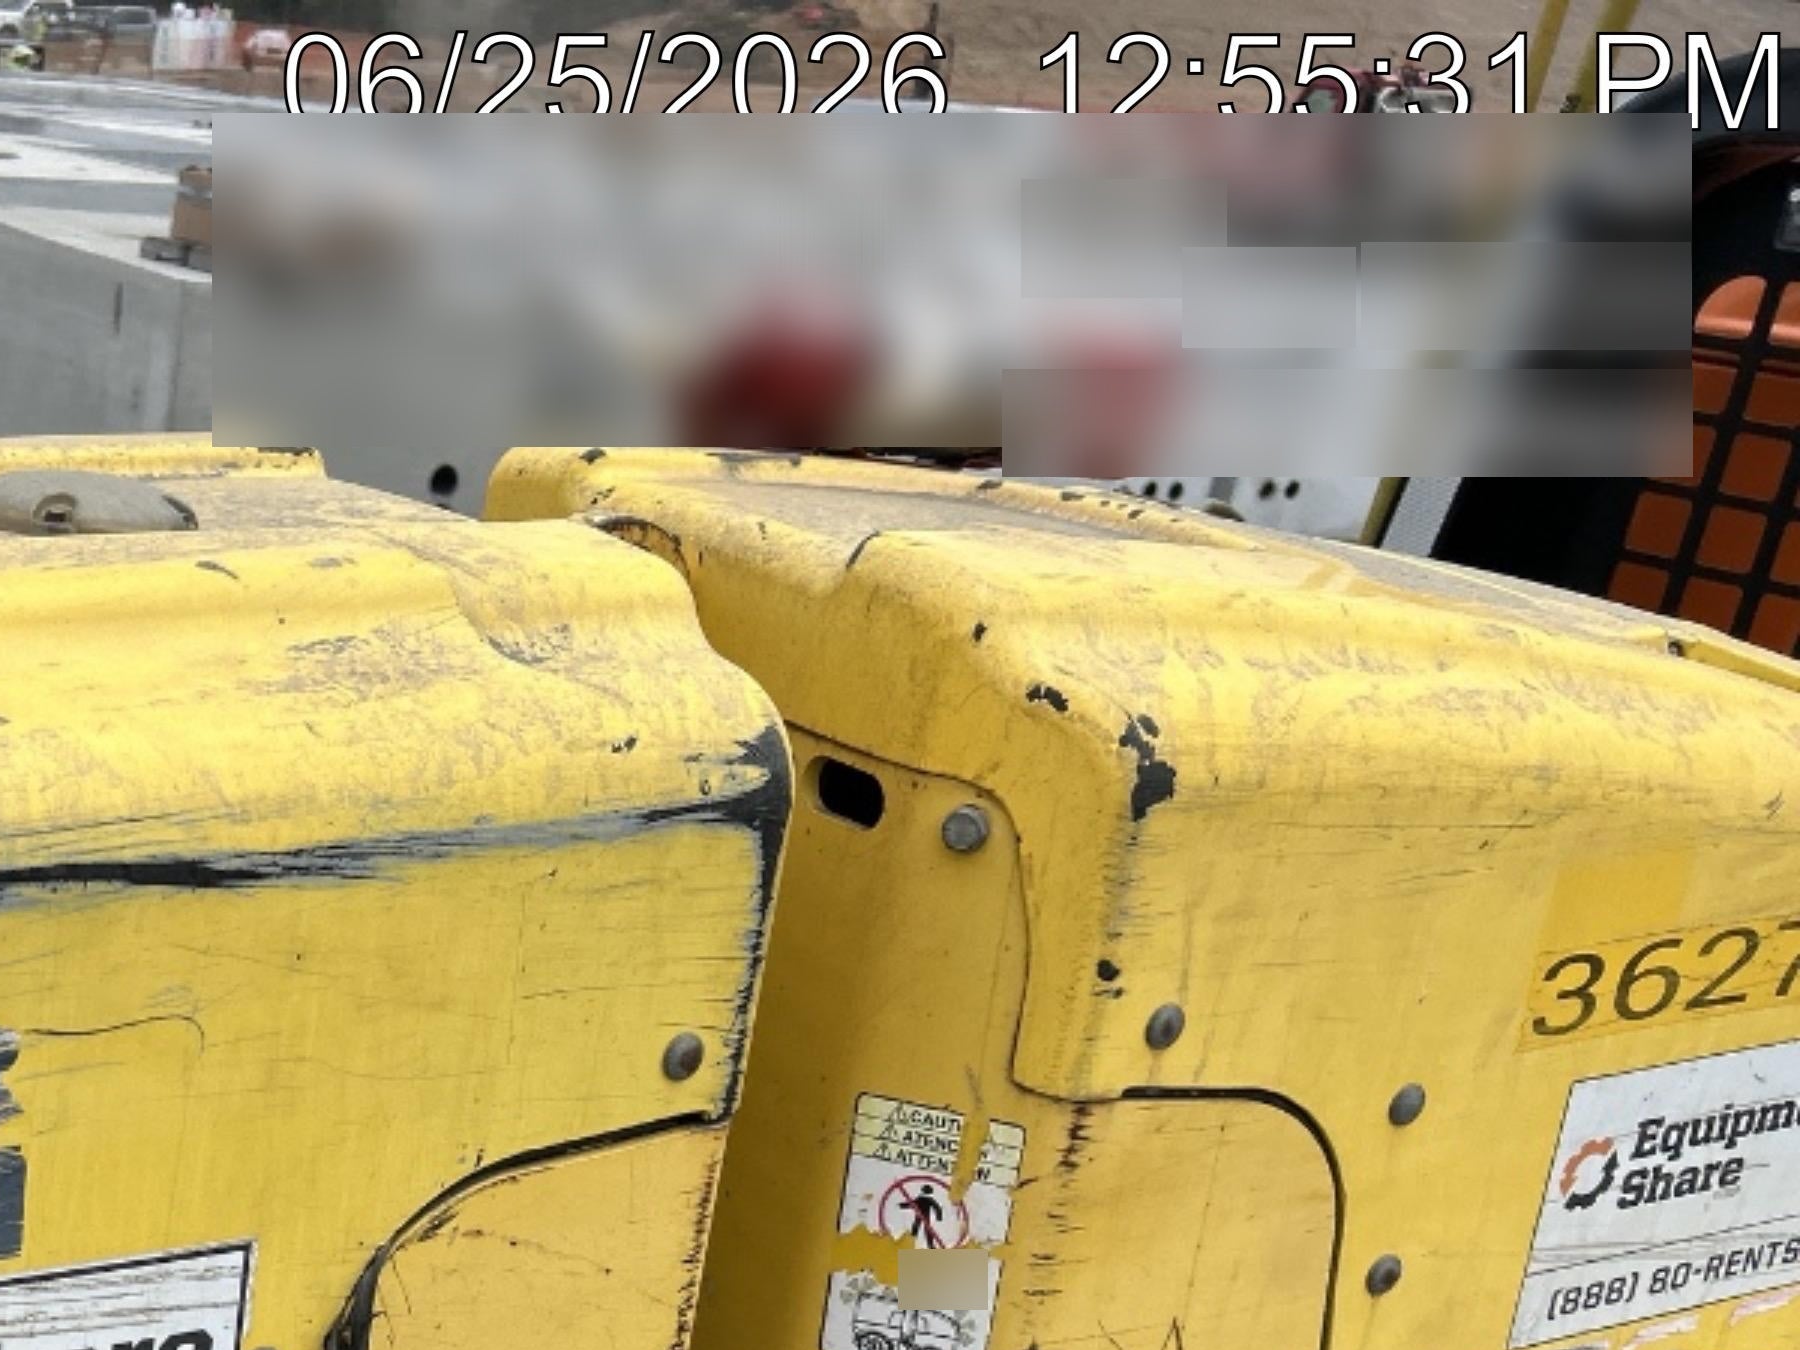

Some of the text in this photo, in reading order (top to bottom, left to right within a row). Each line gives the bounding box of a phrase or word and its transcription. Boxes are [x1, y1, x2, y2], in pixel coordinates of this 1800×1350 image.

[1629, 1100, 1800, 1162] Equipm
[1617, 1157, 1744, 1210] Share
[1547, 1238, 1800, 1321] (888) 80-RENTS
